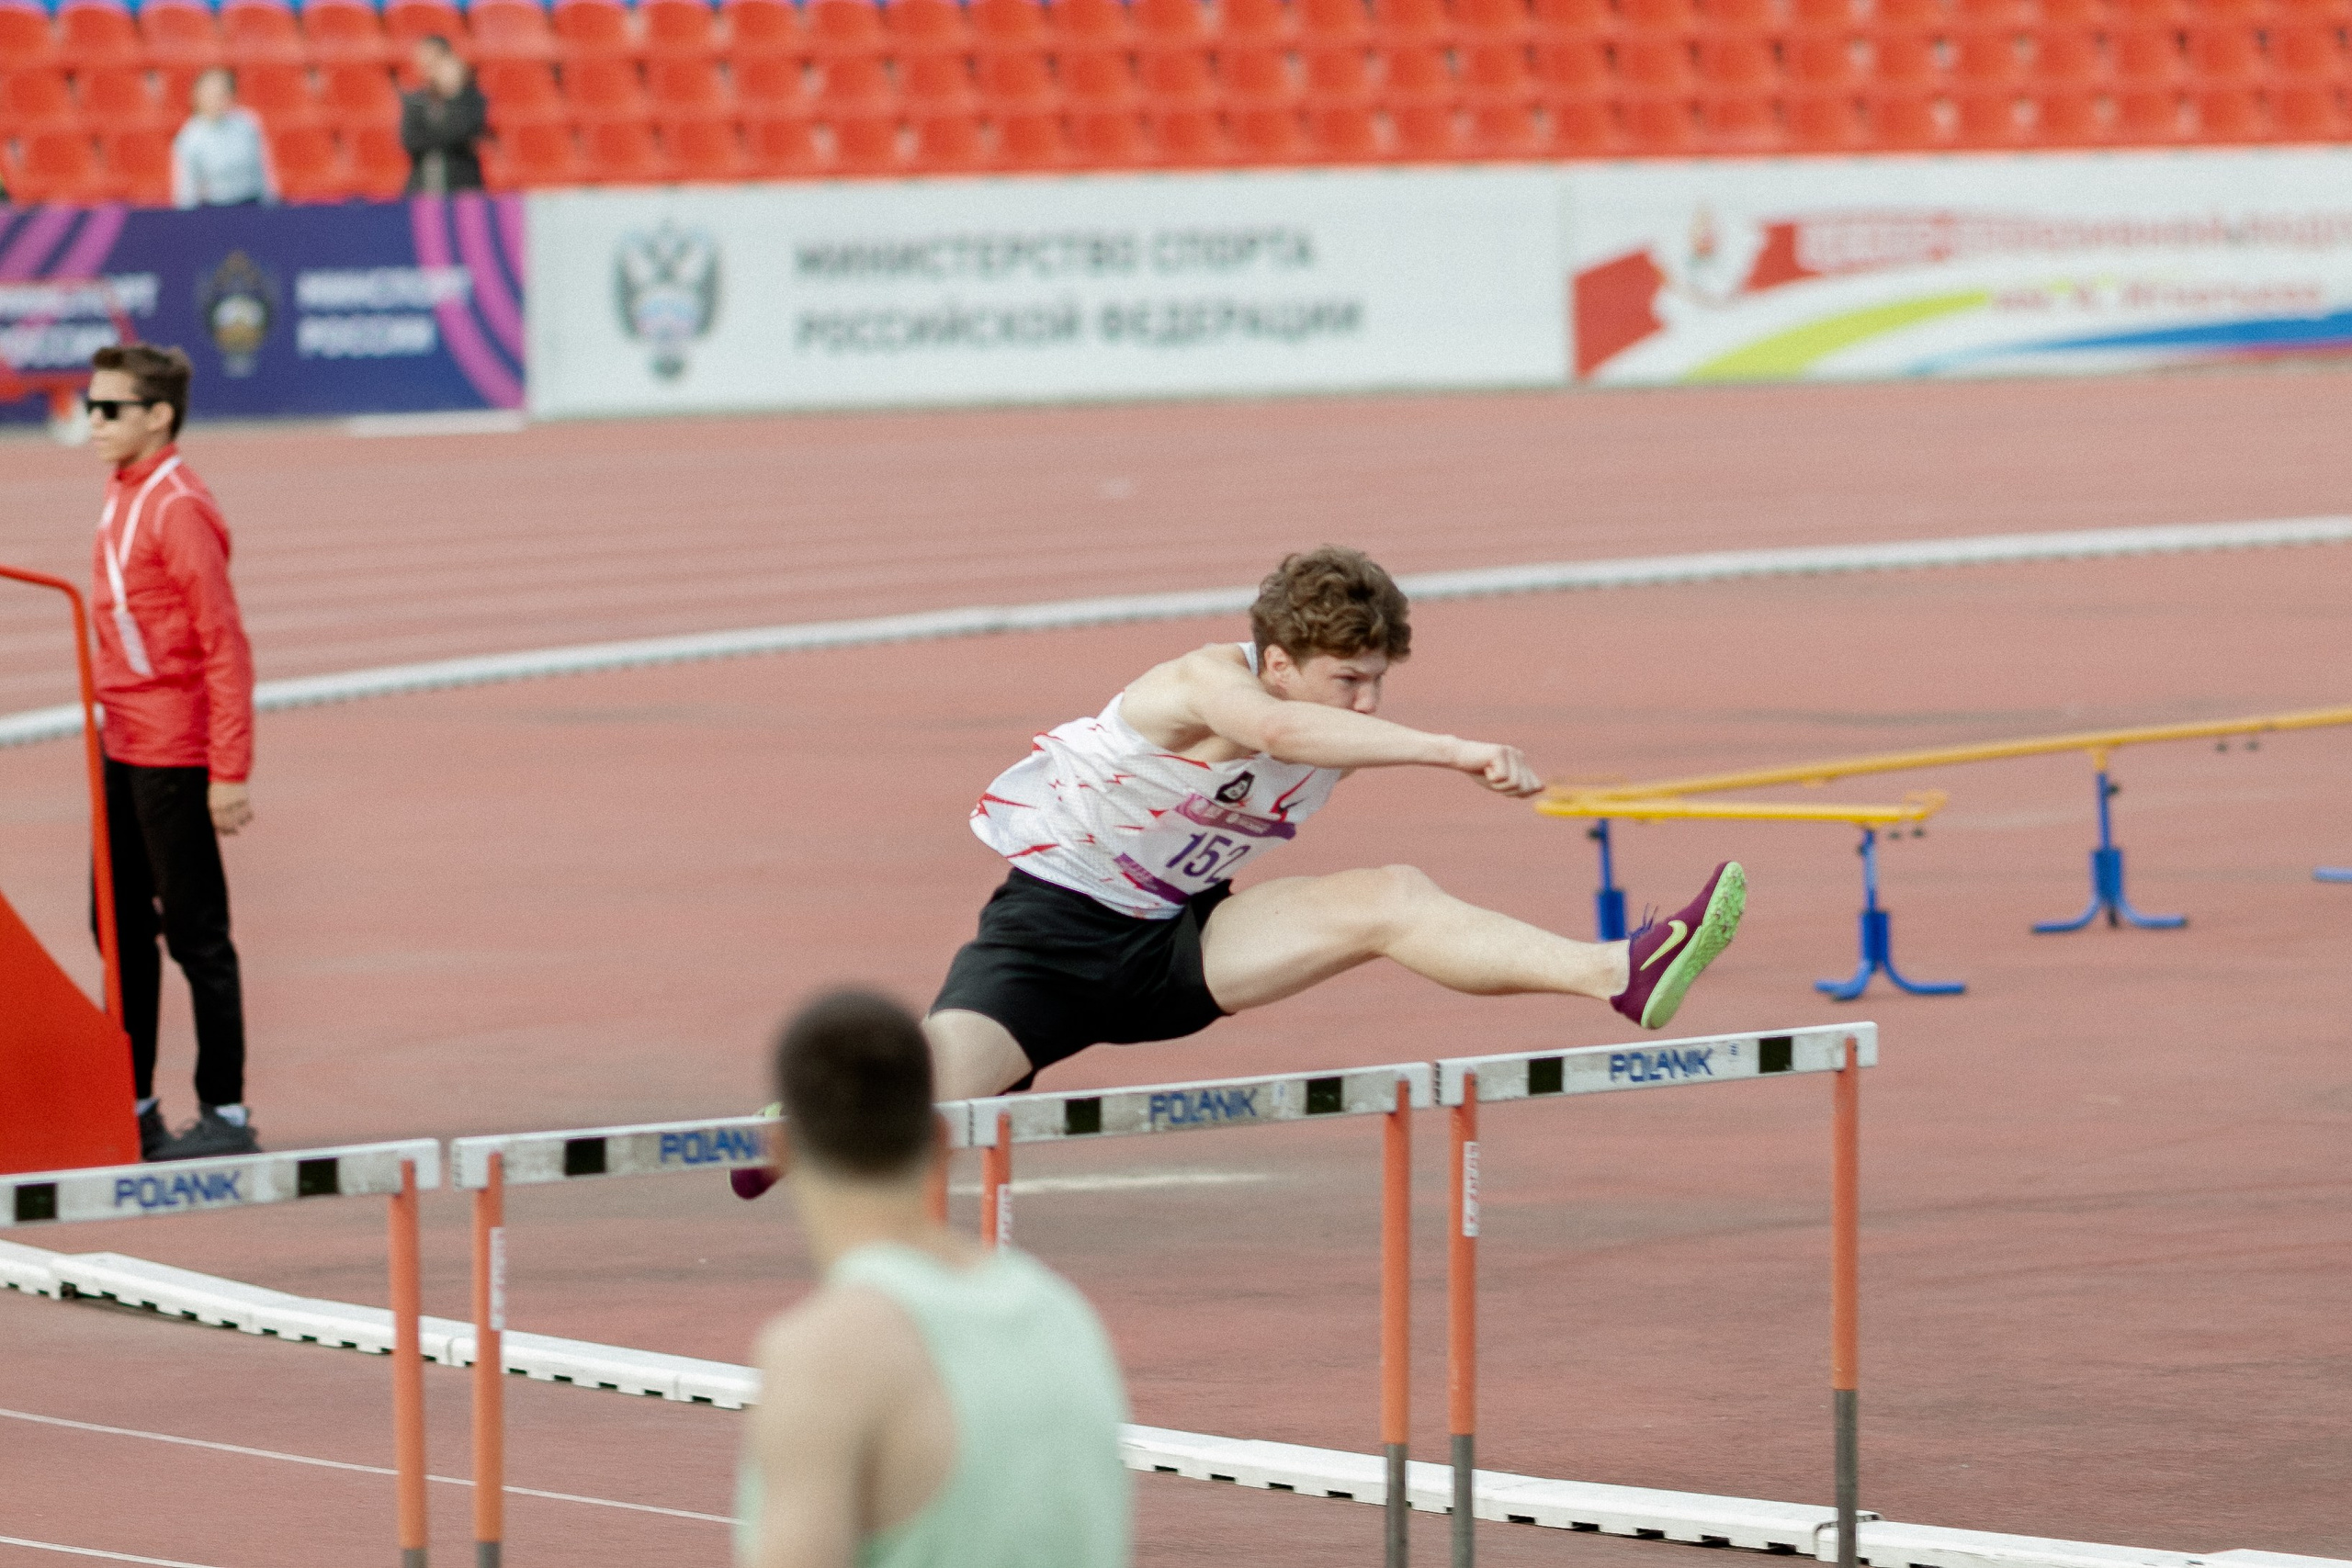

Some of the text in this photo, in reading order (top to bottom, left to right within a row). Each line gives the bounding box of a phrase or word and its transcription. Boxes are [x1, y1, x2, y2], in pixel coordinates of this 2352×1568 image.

[796, 228, 1314, 276] МИНИСТЕРСТВО СПОРТА
[796, 298, 1365, 352] РОССИЙСКОЙ ФЕДЕРАЦИИ
[1166, 832, 1250, 883] 152
[1610, 1047, 1714, 1082] POLANIK
[1149, 1088, 1259, 1124] POLANIK
[660, 1129, 763, 1164] POLAN
[114, 1170, 242, 1208] POLANIK
